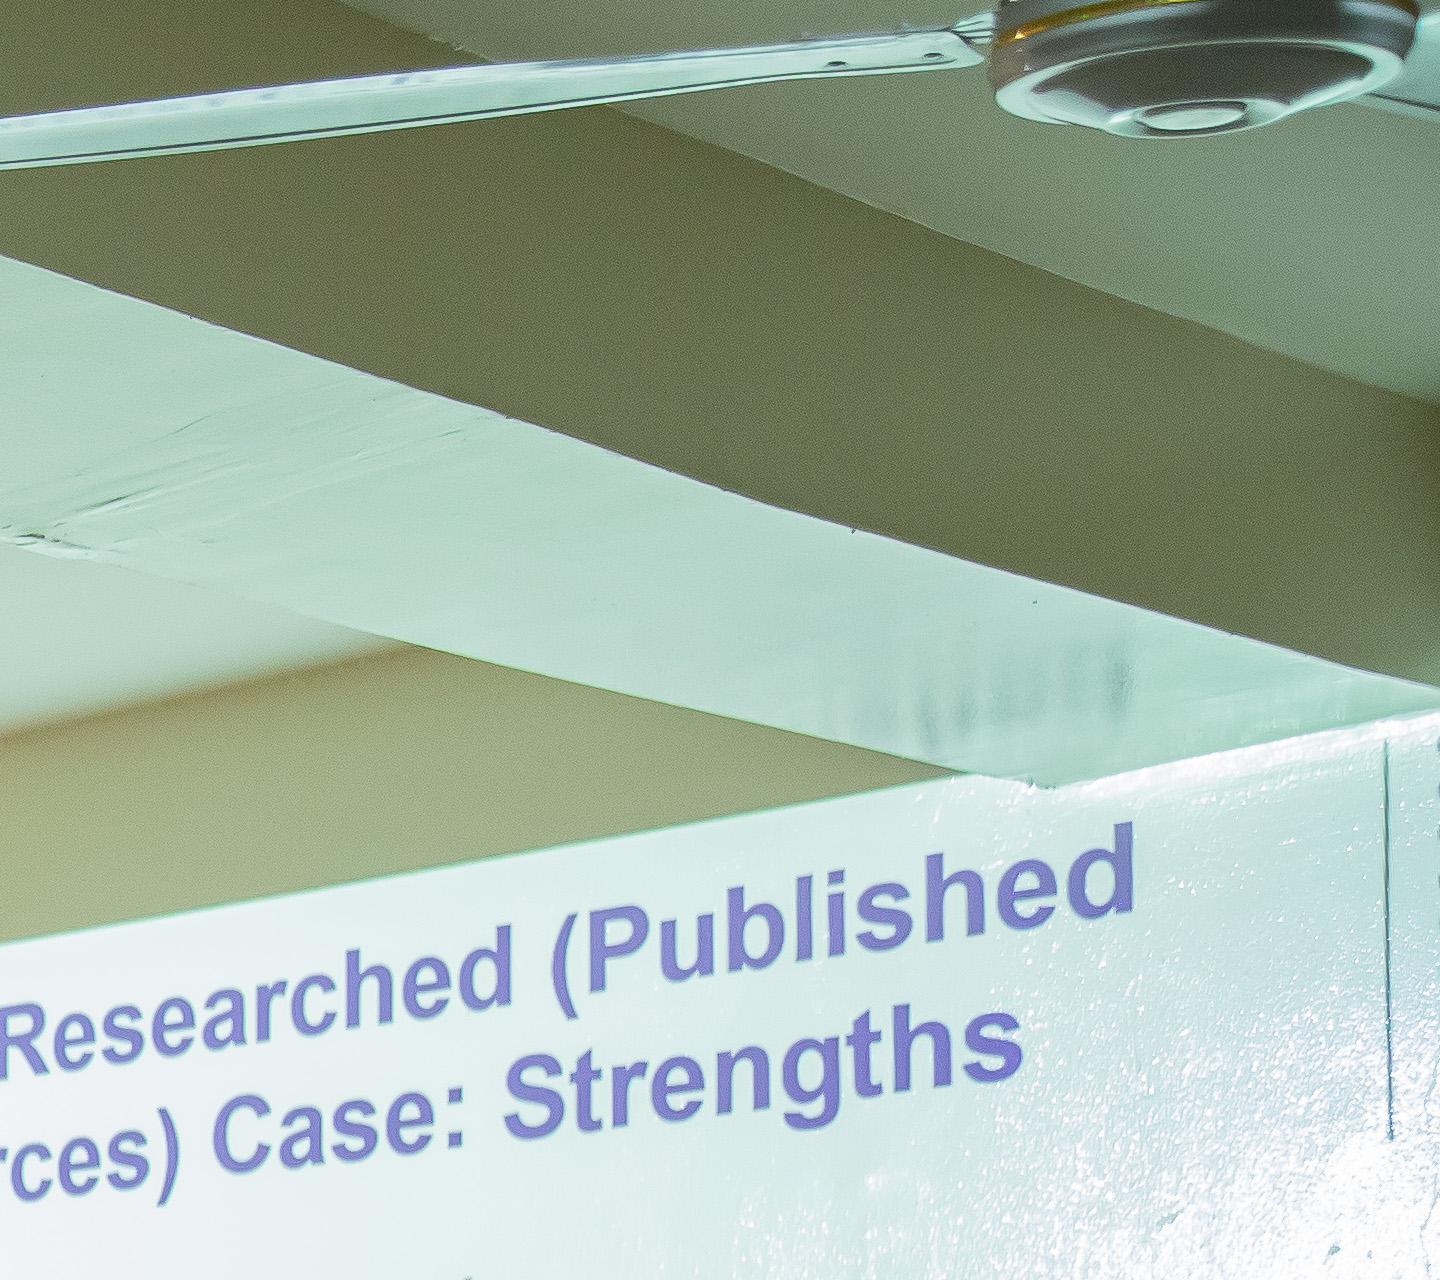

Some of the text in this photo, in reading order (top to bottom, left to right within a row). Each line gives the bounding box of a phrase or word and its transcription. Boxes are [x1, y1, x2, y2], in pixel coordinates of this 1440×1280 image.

[552, 822, 1133, 1019] (Published
[213, 1087, 463, 1174] Case:
[504, 1004, 1023, 1140] Strengths
